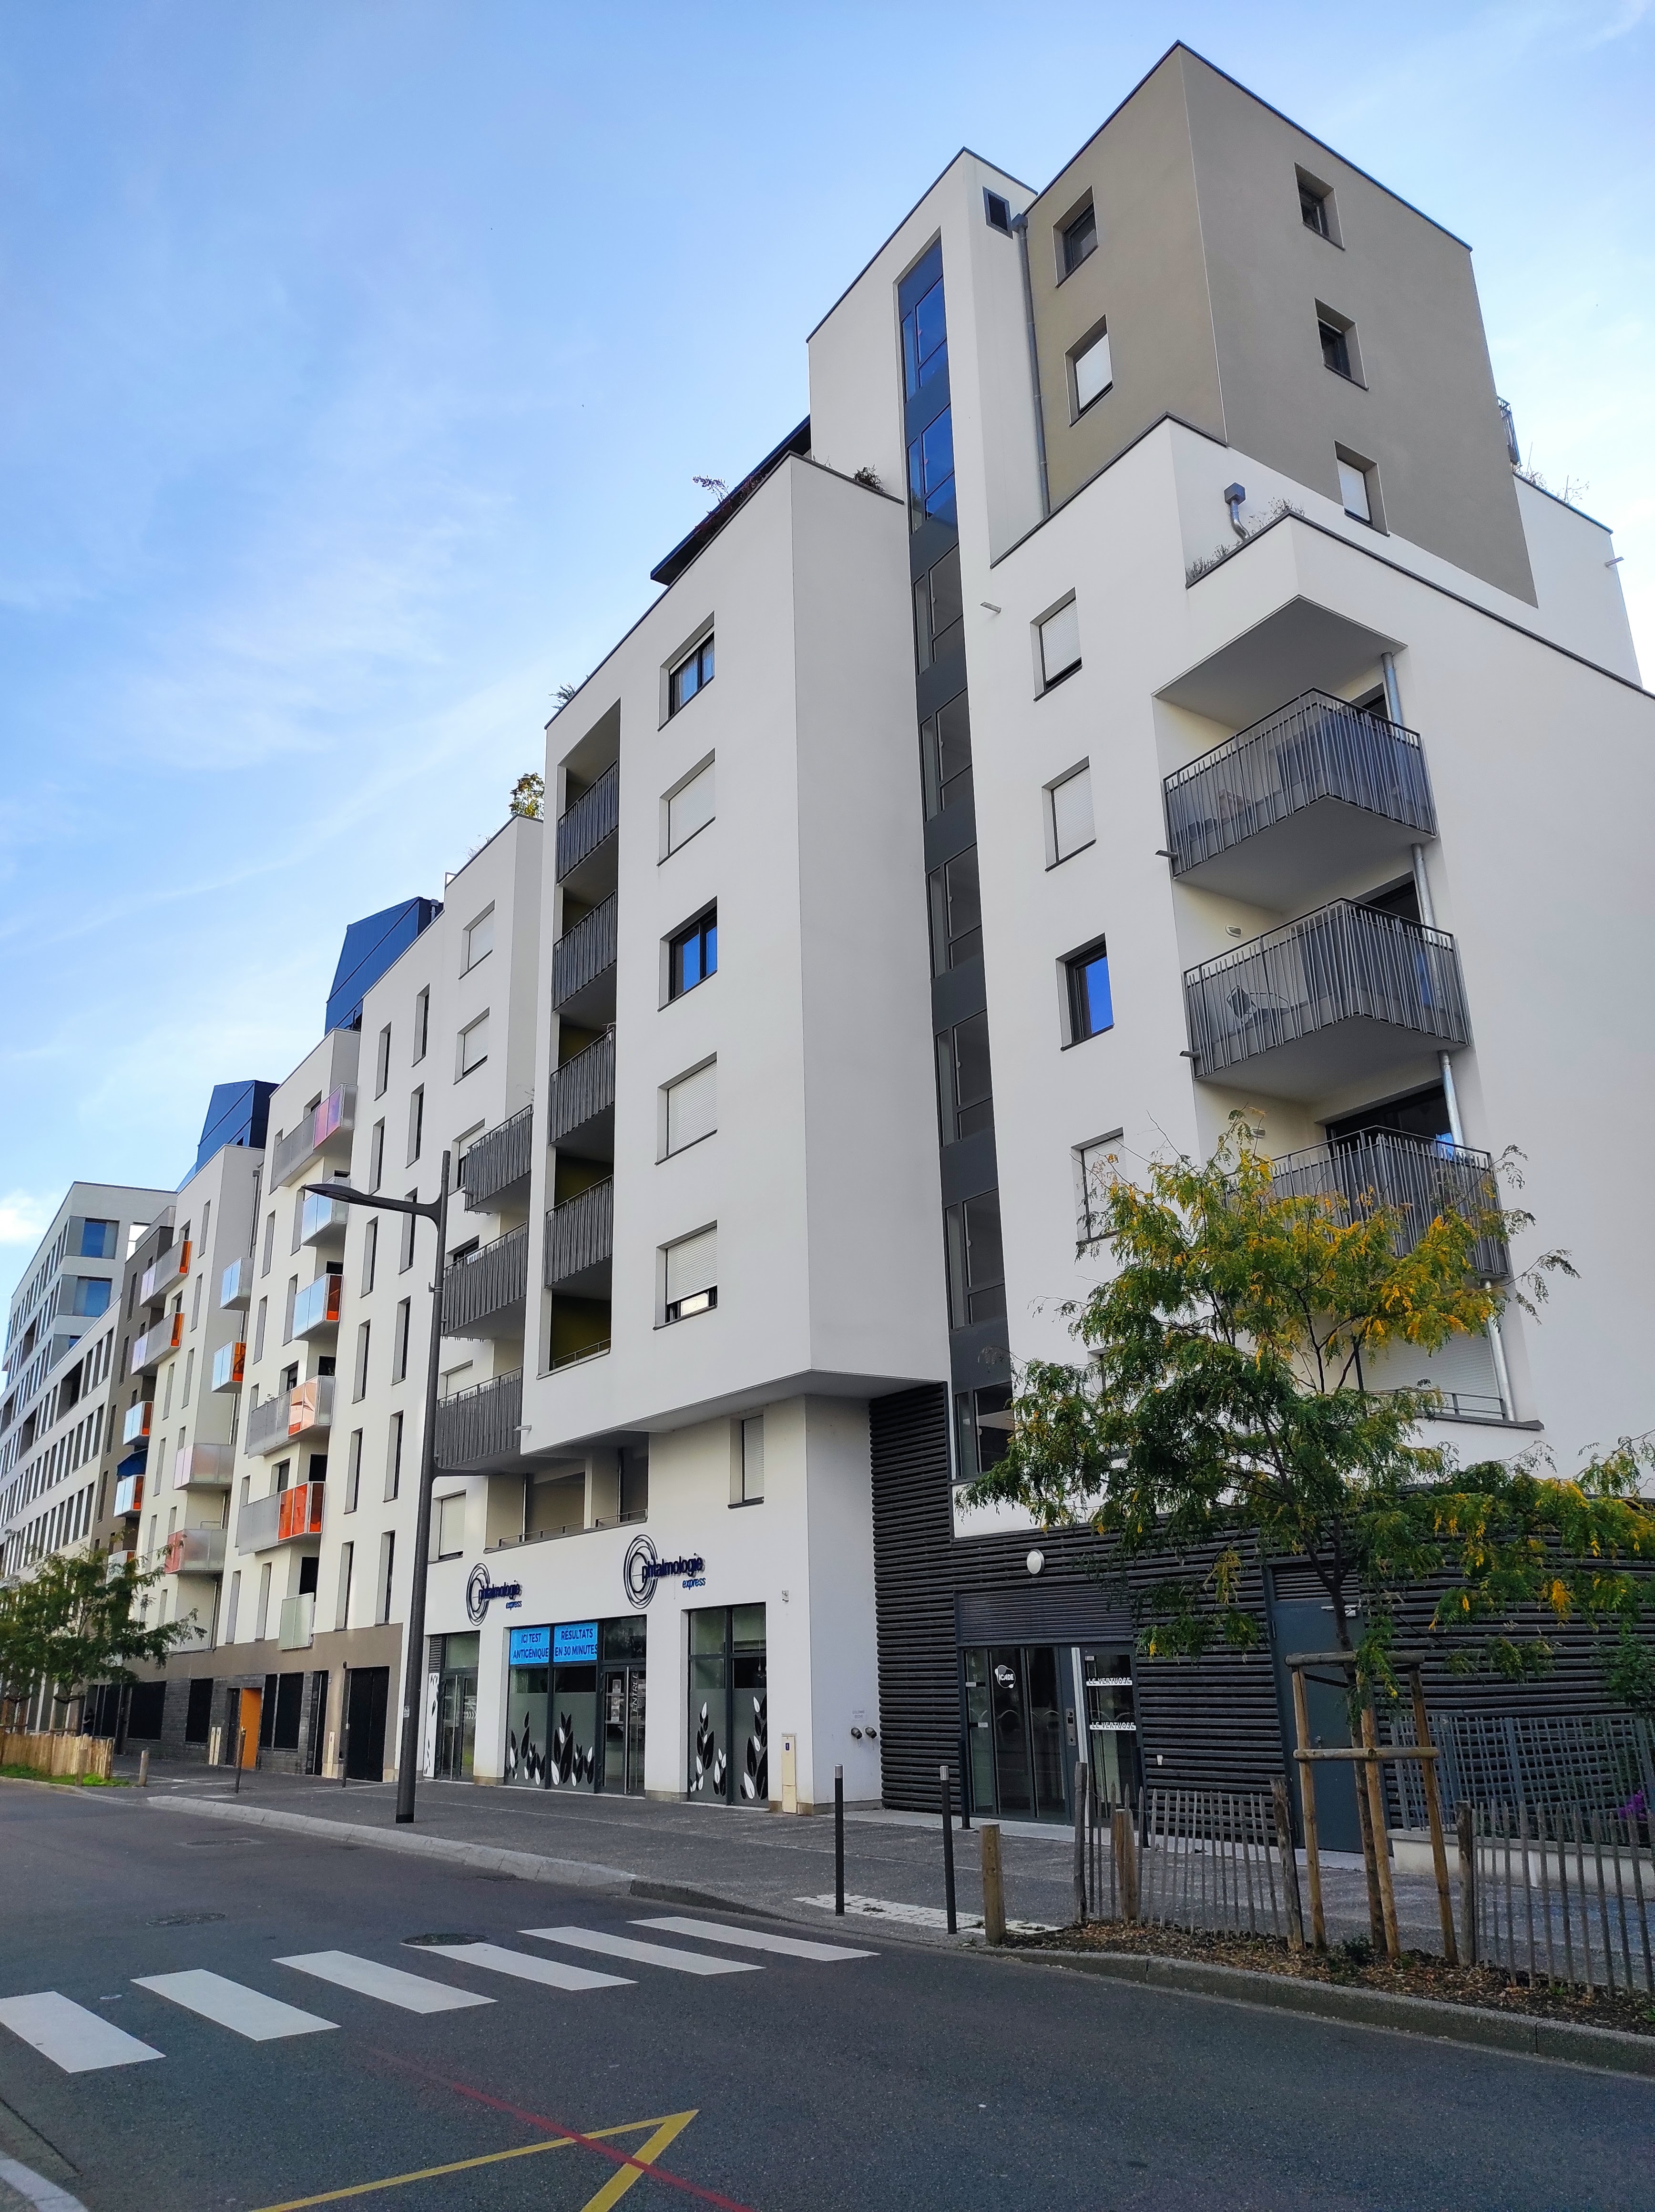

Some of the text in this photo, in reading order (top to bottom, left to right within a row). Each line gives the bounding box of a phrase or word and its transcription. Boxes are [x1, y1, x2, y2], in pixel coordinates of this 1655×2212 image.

[682, 1577, 706, 1590] express
[529, 1632, 542, 1643] TEST
[561, 1628, 593, 1640] RÉSULTATS
[513, 1646, 549, 1659] ANTIGÉNIQUE
[555, 1644, 598, 1657] EN 30 MINUTES
